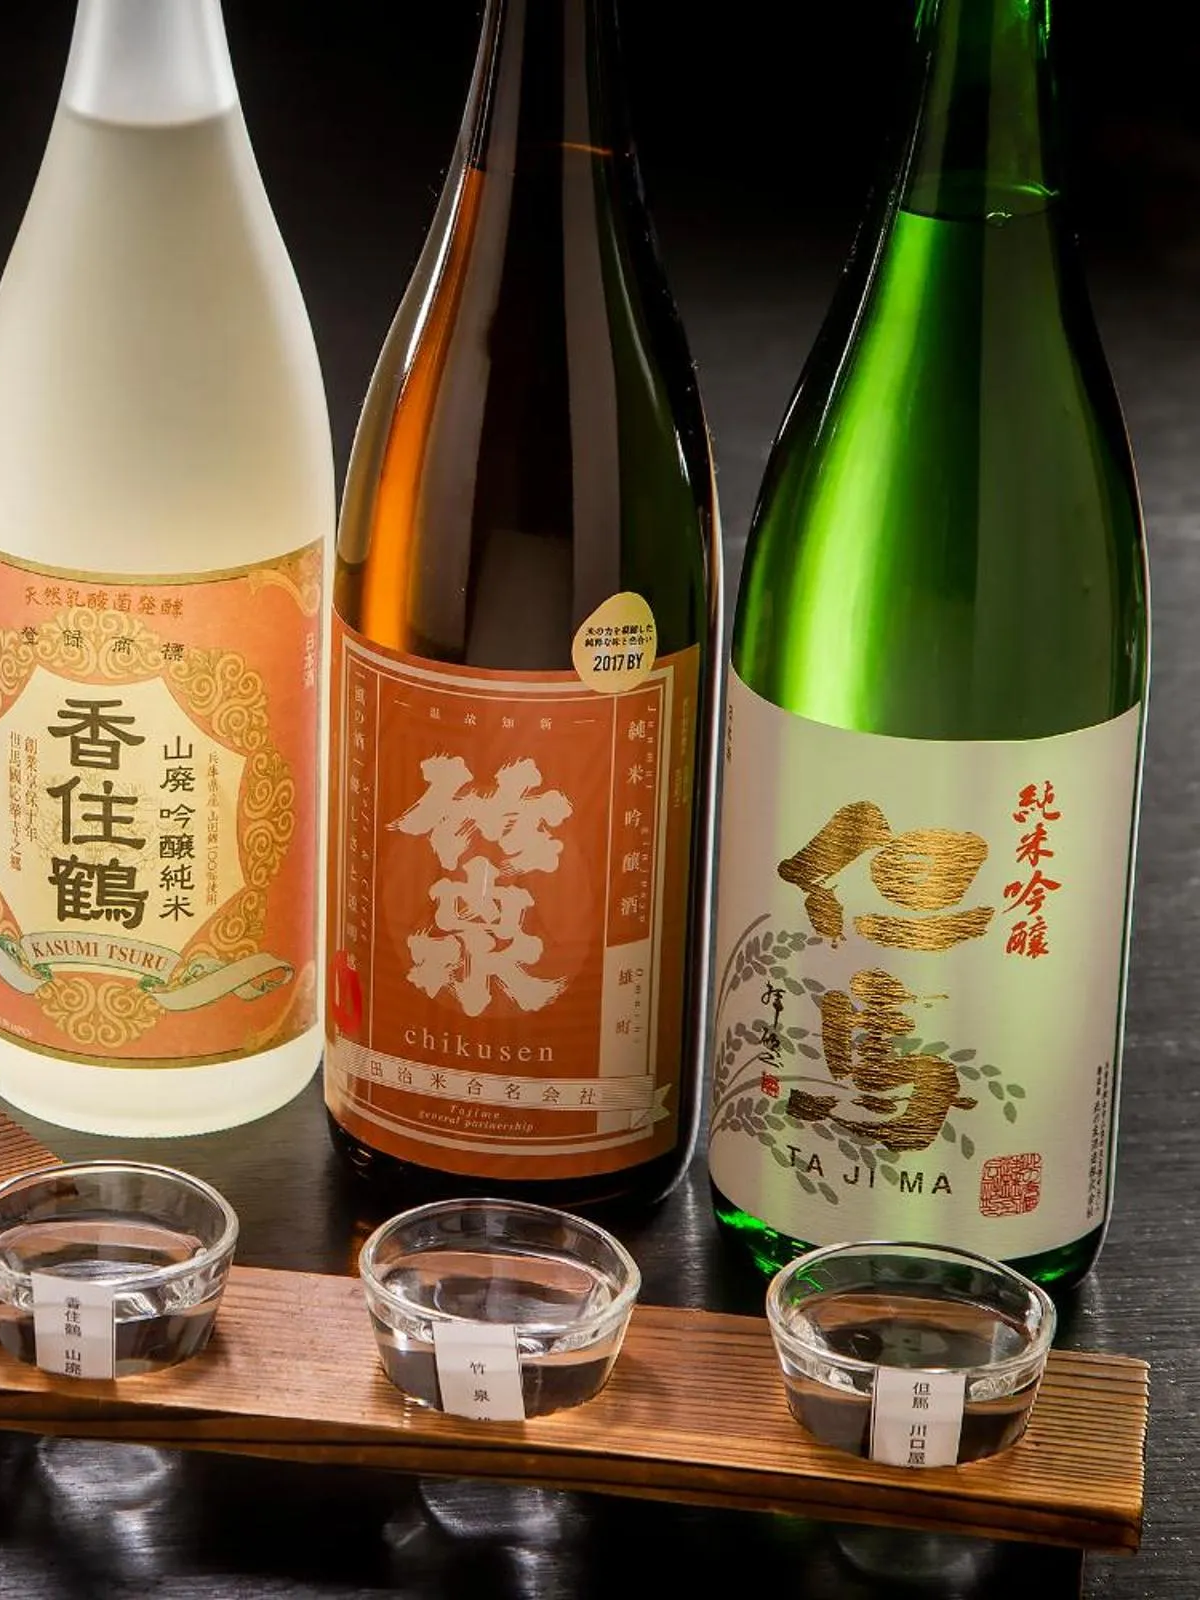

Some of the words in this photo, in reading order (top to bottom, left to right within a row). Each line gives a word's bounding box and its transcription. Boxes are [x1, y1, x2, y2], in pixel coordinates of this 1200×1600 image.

[25, 586, 185, 618] 天然乳酸菌発酵
[21, 626, 185, 662] 登録商標
[593, 654, 625, 672] 2017
[627, 652, 645, 670] BY
[430, 707, 552, 730] 温故知新
[47, 698, 150, 930] 香住鶴
[620, 718, 647, 918] 純米吟醸酒
[386, 752, 574, 1017] 竹泉
[1002, 780, 1062, 959] 純米吟醸
[32, 939, 99, 959] KASUMI
[107, 945, 170, 971] TSURU
[778, 801, 996, 1152] 但馬
[405, 1027, 555, 1063] chikusen
[370, 1059, 597, 1106] 田治米合名会社
[418, 1110, 461, 1125] general
[464, 1119, 535, 1133] partnership
[469, 1361, 491, 1403] 竹泉
[912, 1381, 931, 1410] 但馬
[907, 1424, 928, 1465] 川口屋
